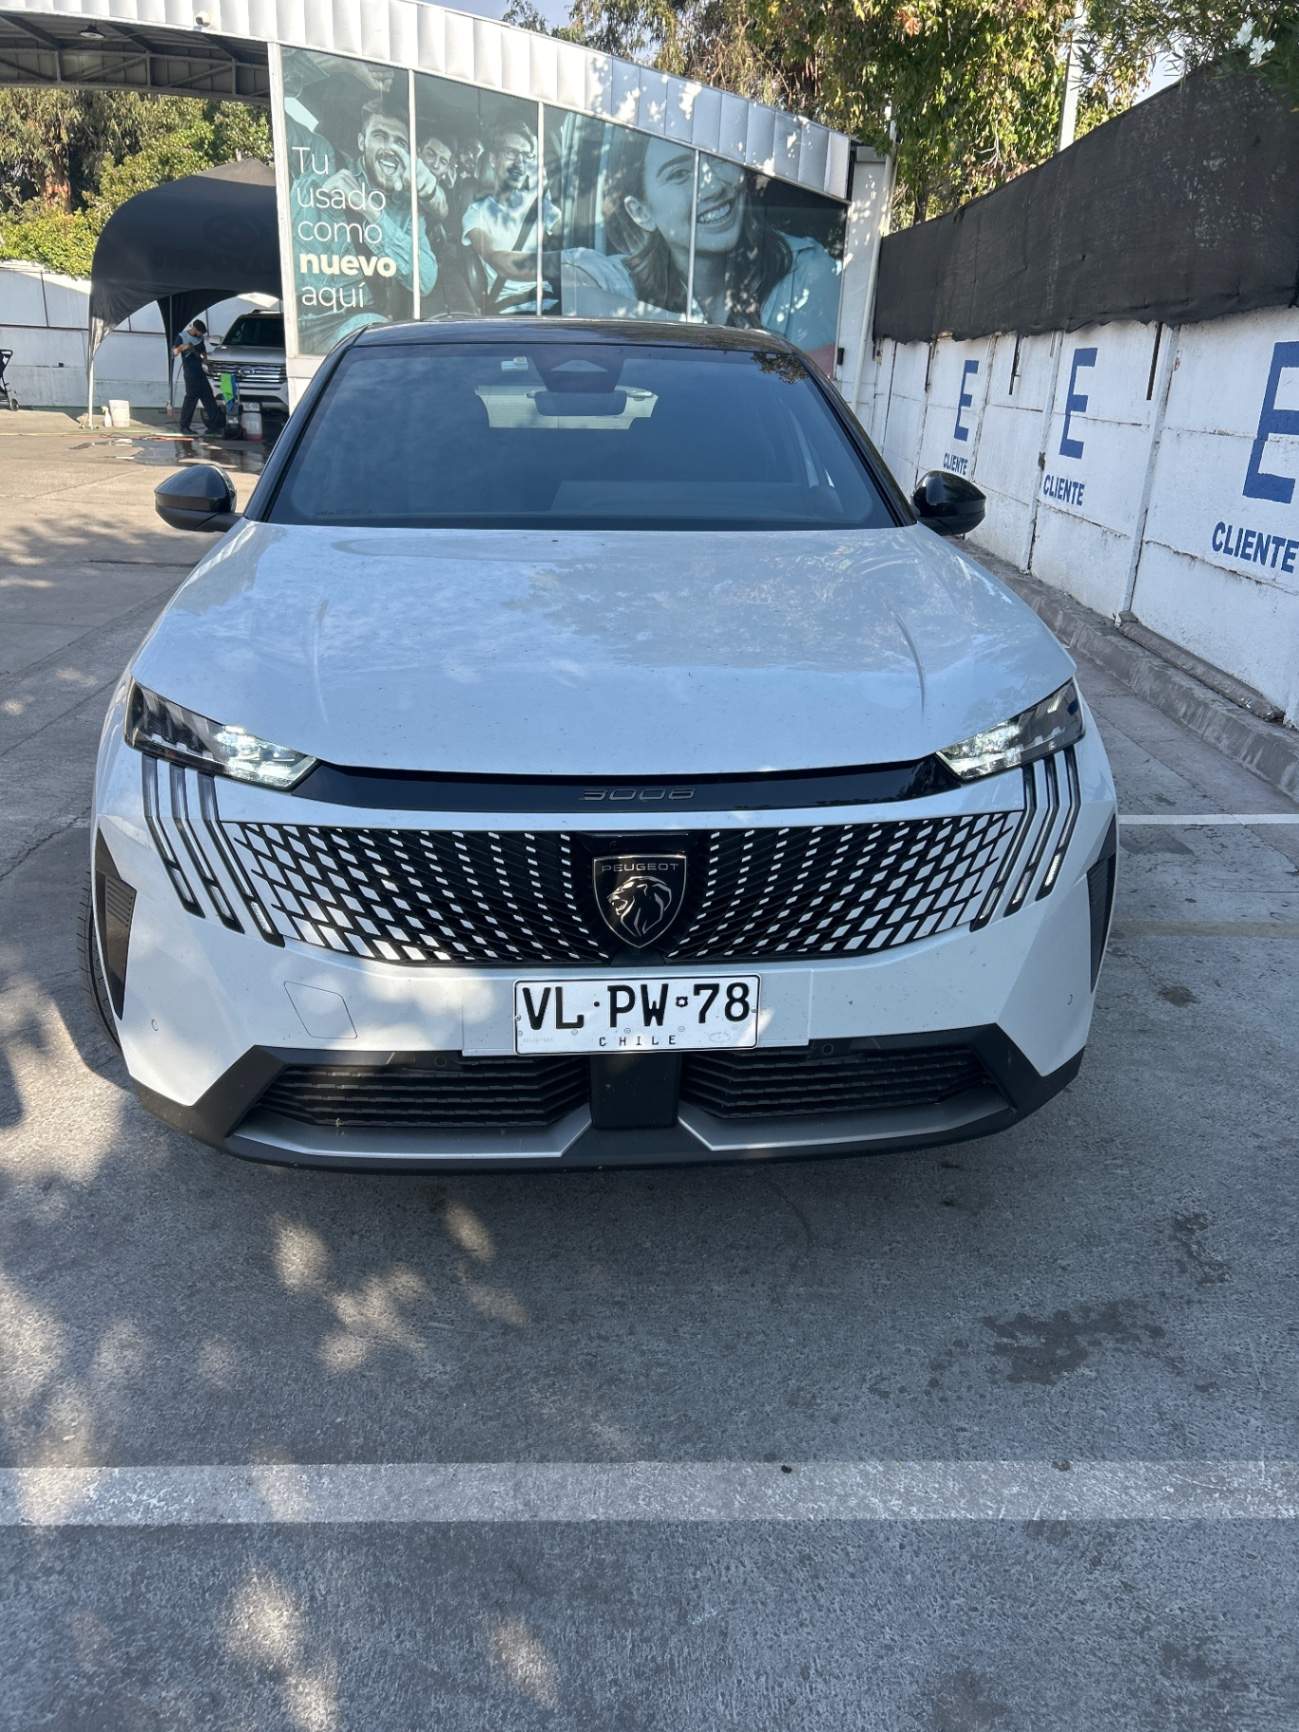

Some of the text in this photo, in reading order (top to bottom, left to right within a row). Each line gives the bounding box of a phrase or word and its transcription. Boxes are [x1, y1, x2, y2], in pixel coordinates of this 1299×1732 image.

[292, 146, 329, 175] Tu
[296, 182, 386, 211] usado
[297, 220, 383, 244] como
[299, 252, 397, 278] nuevo
[302, 281, 366, 312] aquí
[954, 360, 979, 441] E
[1059, 347, 1098, 459] E
[1242, 341, 1299, 504] E
[943, 452, 969, 475] CLIENTE
[1043, 474, 1085, 506] CLIENTE
[1212, 521, 1299, 574] CLIENTE
[583, 787, 696, 800] 3008
[601, 863, 679, 872] PEUGEOT
[599, 1034, 676, 1047] CHILE
